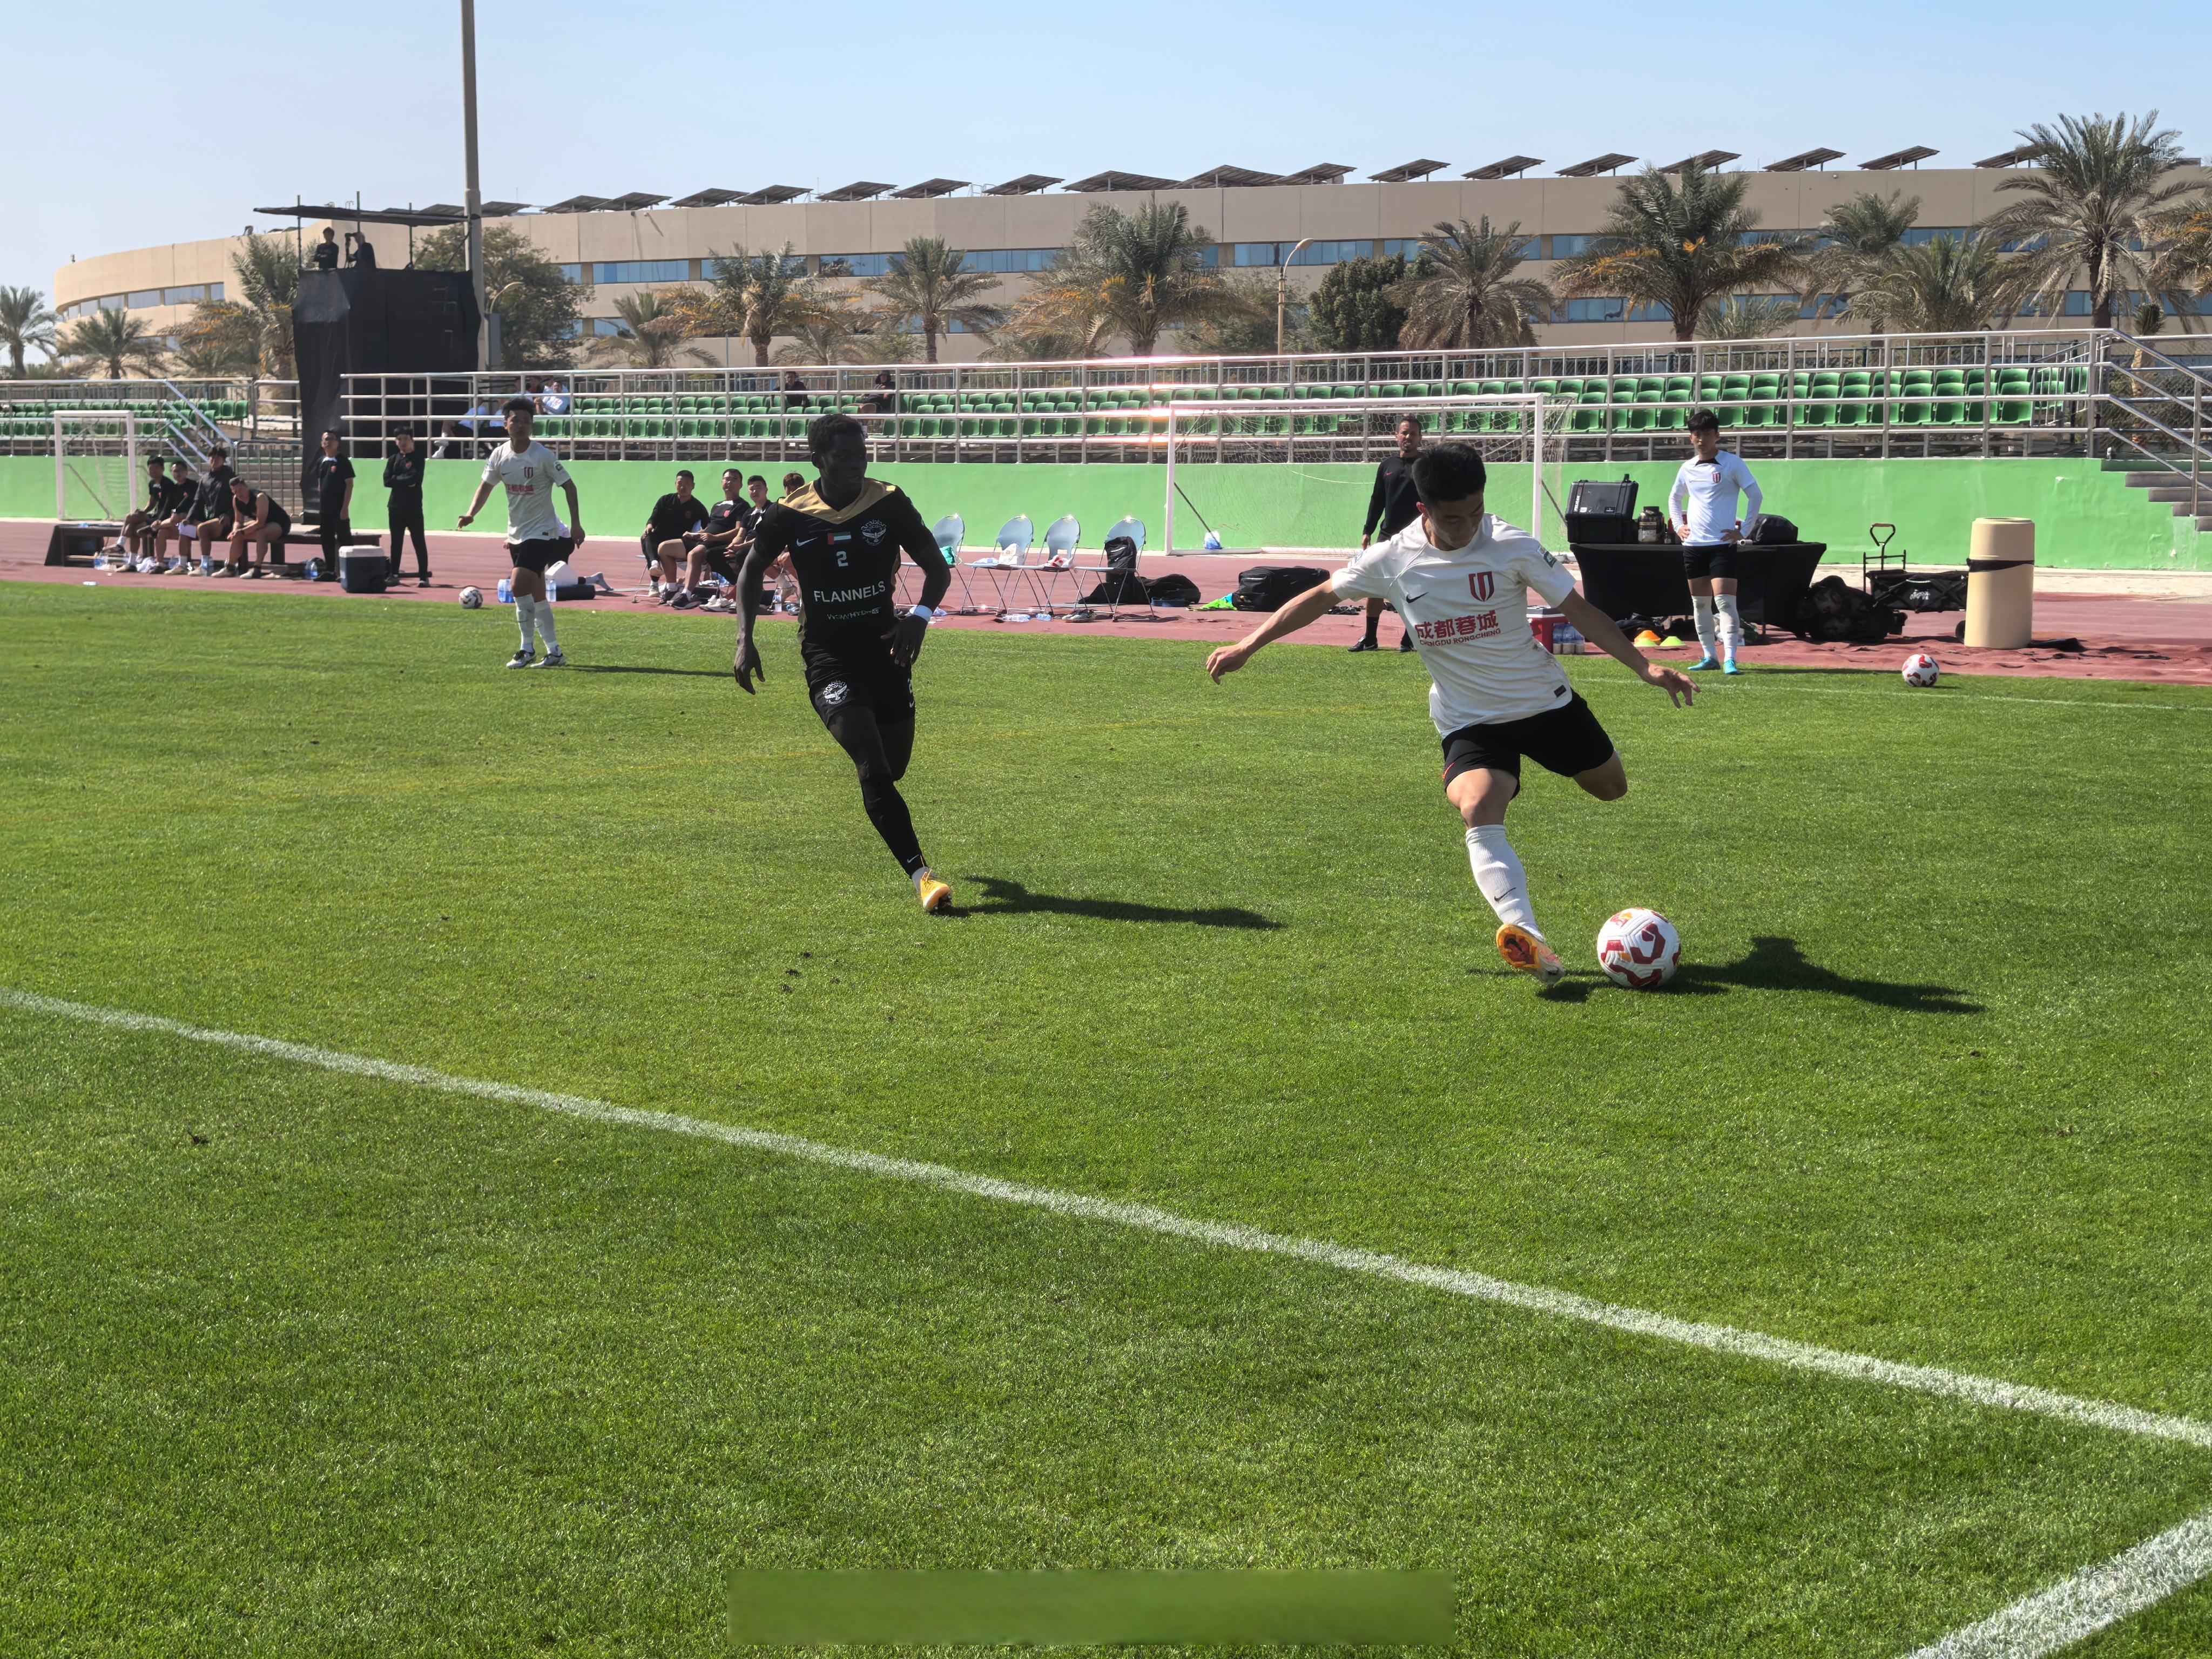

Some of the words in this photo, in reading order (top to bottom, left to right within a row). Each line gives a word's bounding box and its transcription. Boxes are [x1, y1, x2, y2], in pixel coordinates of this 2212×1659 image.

[836, 551, 848, 567] 2
[813, 581, 885, 602] FLANNELS
[1415, 610, 1499, 639] 成都蓉城
[1454, 628, 1501, 644] RONGCHENG
